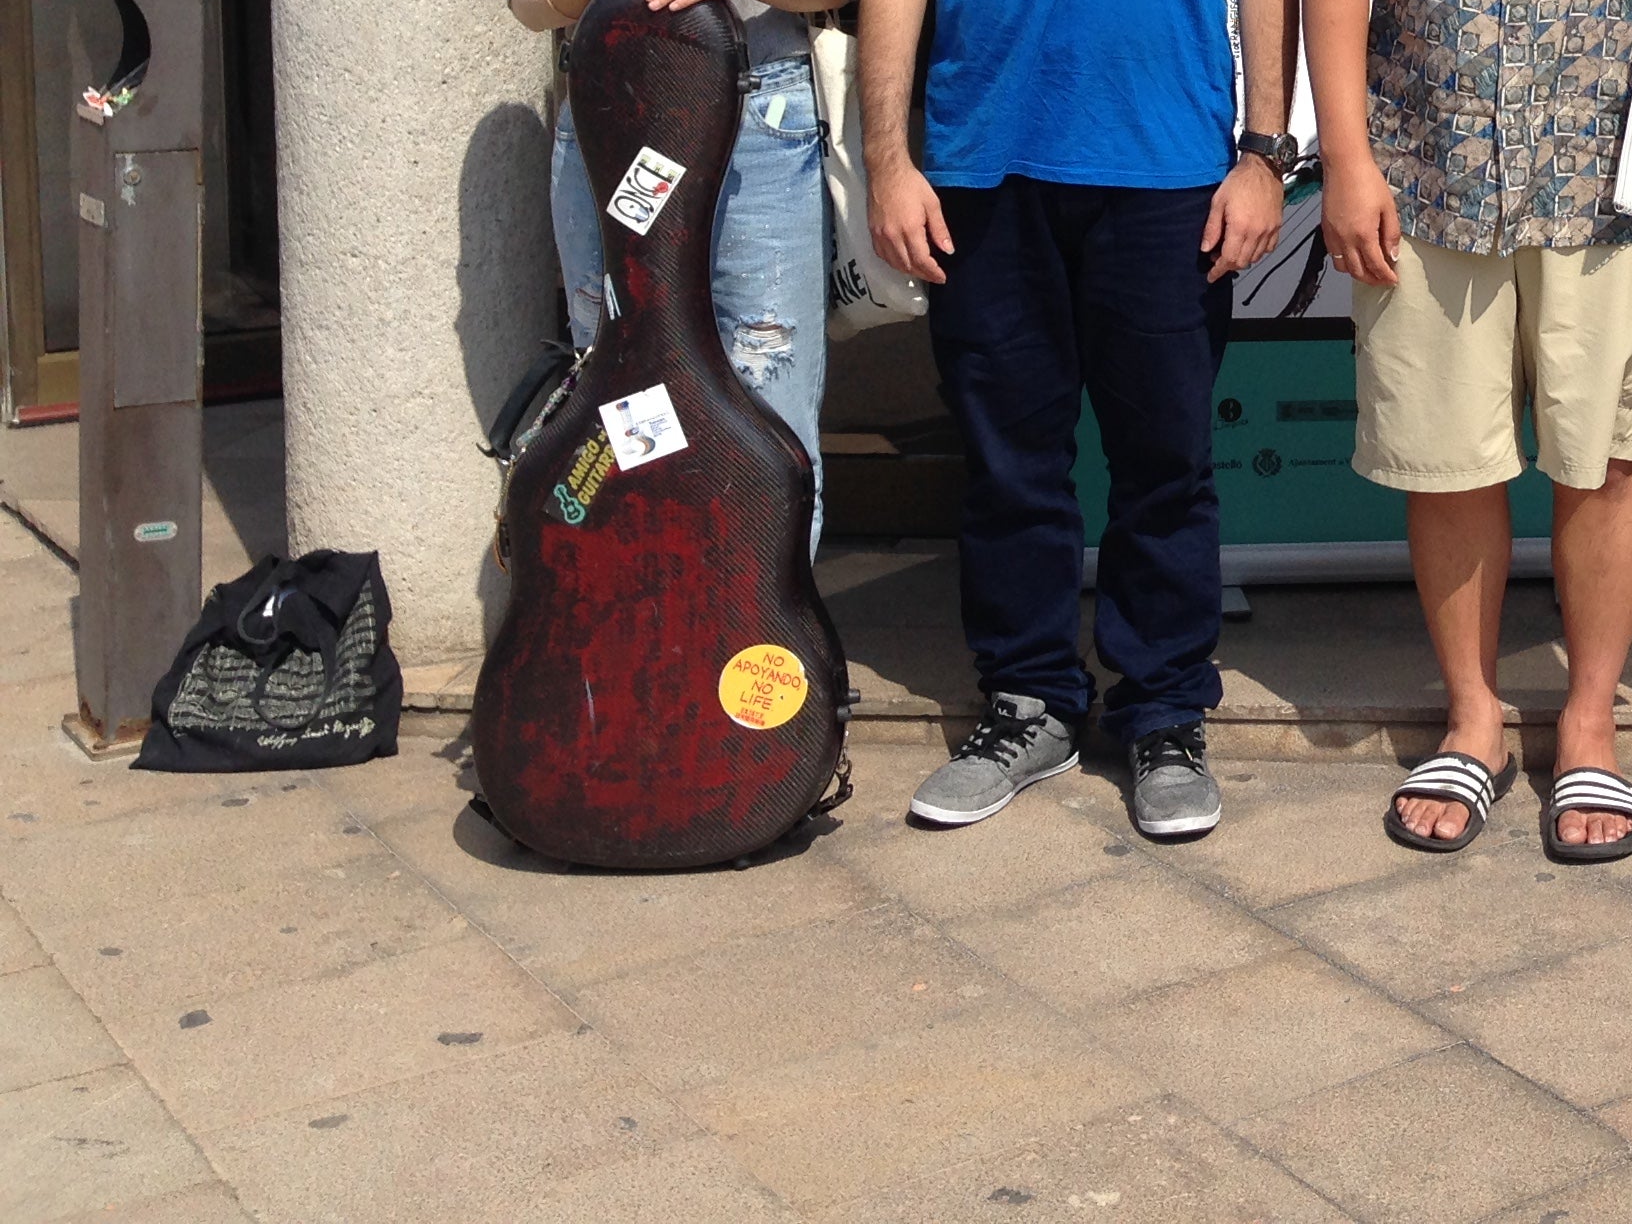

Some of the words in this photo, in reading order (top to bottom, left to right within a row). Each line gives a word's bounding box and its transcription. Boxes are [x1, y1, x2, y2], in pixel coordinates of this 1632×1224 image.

[568, 437, 600, 490] AMIGO
[762, 652, 785, 667] NO
[751, 680, 774, 695] NO
